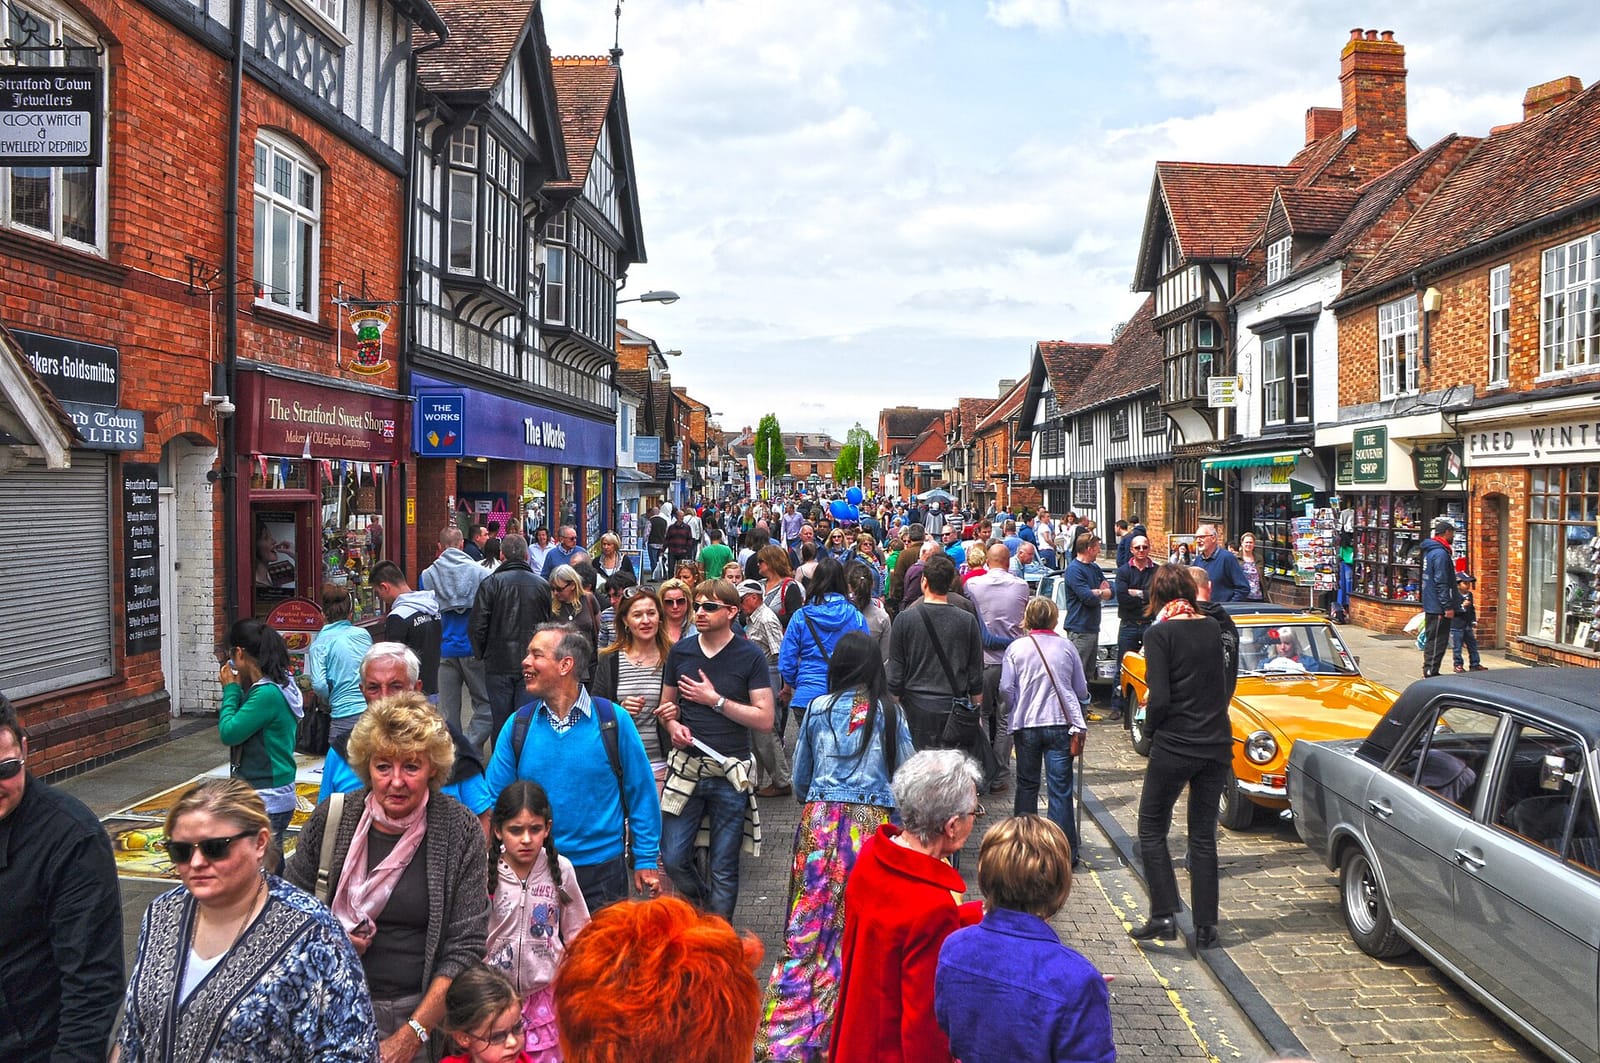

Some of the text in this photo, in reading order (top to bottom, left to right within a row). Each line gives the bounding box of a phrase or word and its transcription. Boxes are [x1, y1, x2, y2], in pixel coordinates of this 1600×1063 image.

[55, 78, 91, 90] Town
[12, 93, 72, 107] Jewellers
[3, 114, 81, 126] CLOCK WATCH
[1, 141, 87, 153] EWELLERY REPAIRS
[432, 404, 452, 412] THE
[95, 412, 137, 429] Town
[268, 398, 384, 434] The Stratford Sweet Shop
[424, 413, 460, 421] WORKS
[285, 430, 305, 443] Makers
[313, 432, 323, 444] Old
[324, 433, 341, 448] English
[524, 418, 566, 450] The Works
[1362, 434, 1376, 446] THE
[1470, 431, 1514, 452] FRED
[1355, 447, 1383, 460] SOUVENIR
[1360, 463, 1377, 474] SHOP
